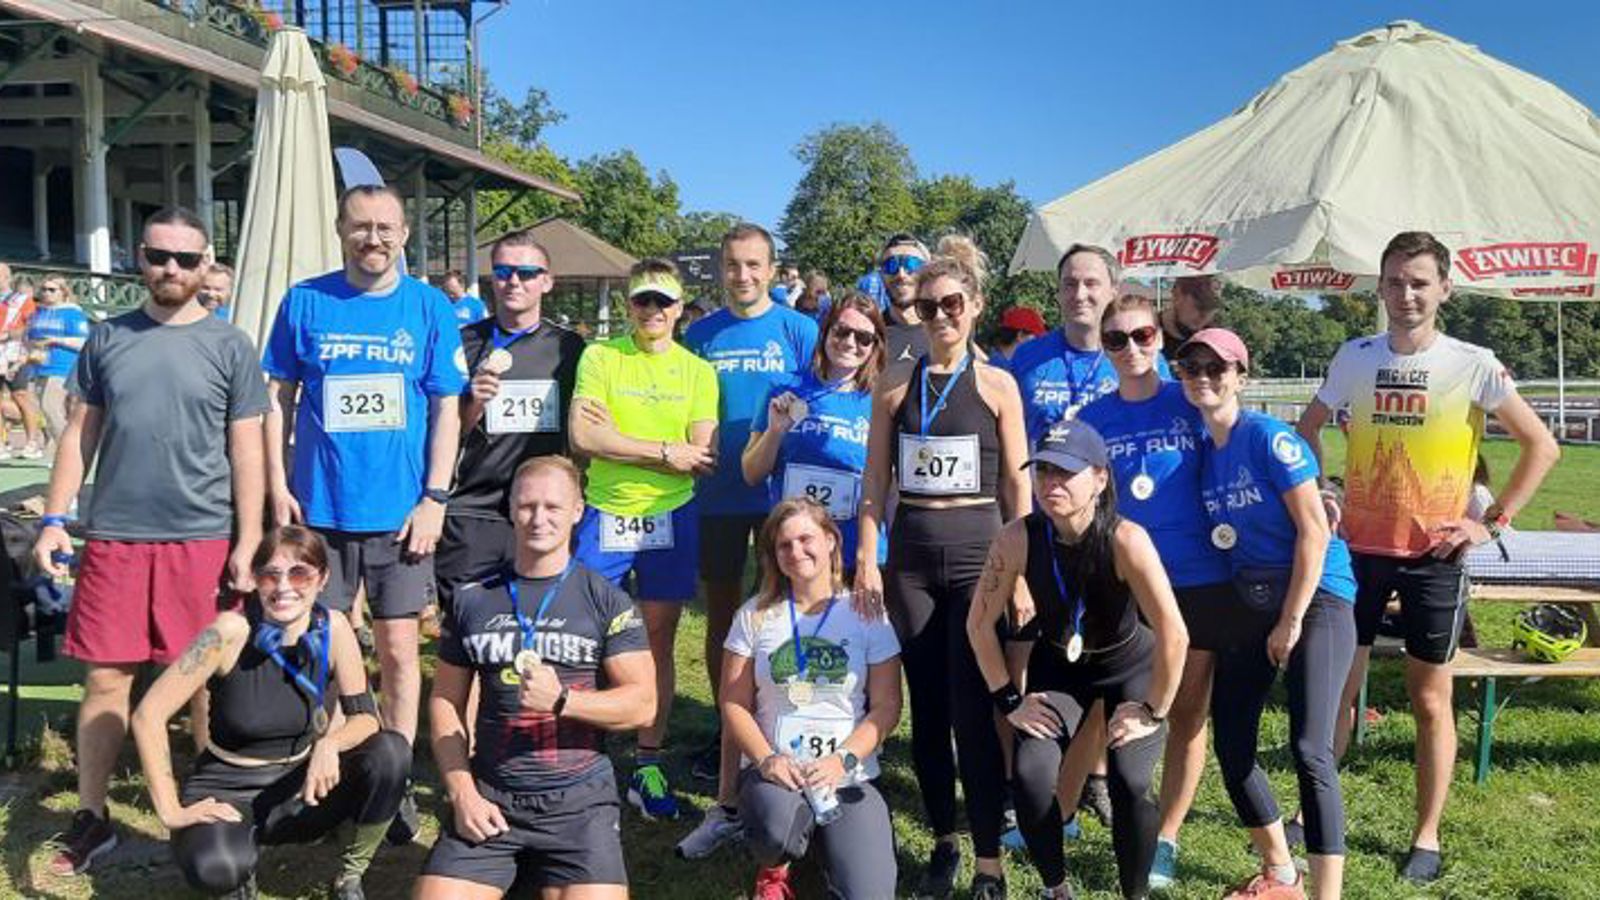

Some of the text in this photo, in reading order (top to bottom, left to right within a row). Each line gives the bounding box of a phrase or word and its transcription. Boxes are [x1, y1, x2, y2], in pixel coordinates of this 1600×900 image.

[1131, 237, 1211, 260] ŻYWIEC
[1469, 246, 1578, 270] ŻYWIEC
[319, 343, 415, 365] ZPF RUN
[710, 358, 786, 373] PF RUN
[340, 393, 386, 415] 323
[502, 397, 545, 417] 219
[1374, 391, 1427, 414] 100
[1105, 442, 1138, 460] PF
[1145, 435, 1196, 453] RUN
[805, 484, 833, 506] 82
[614, 514, 656, 536] 346
